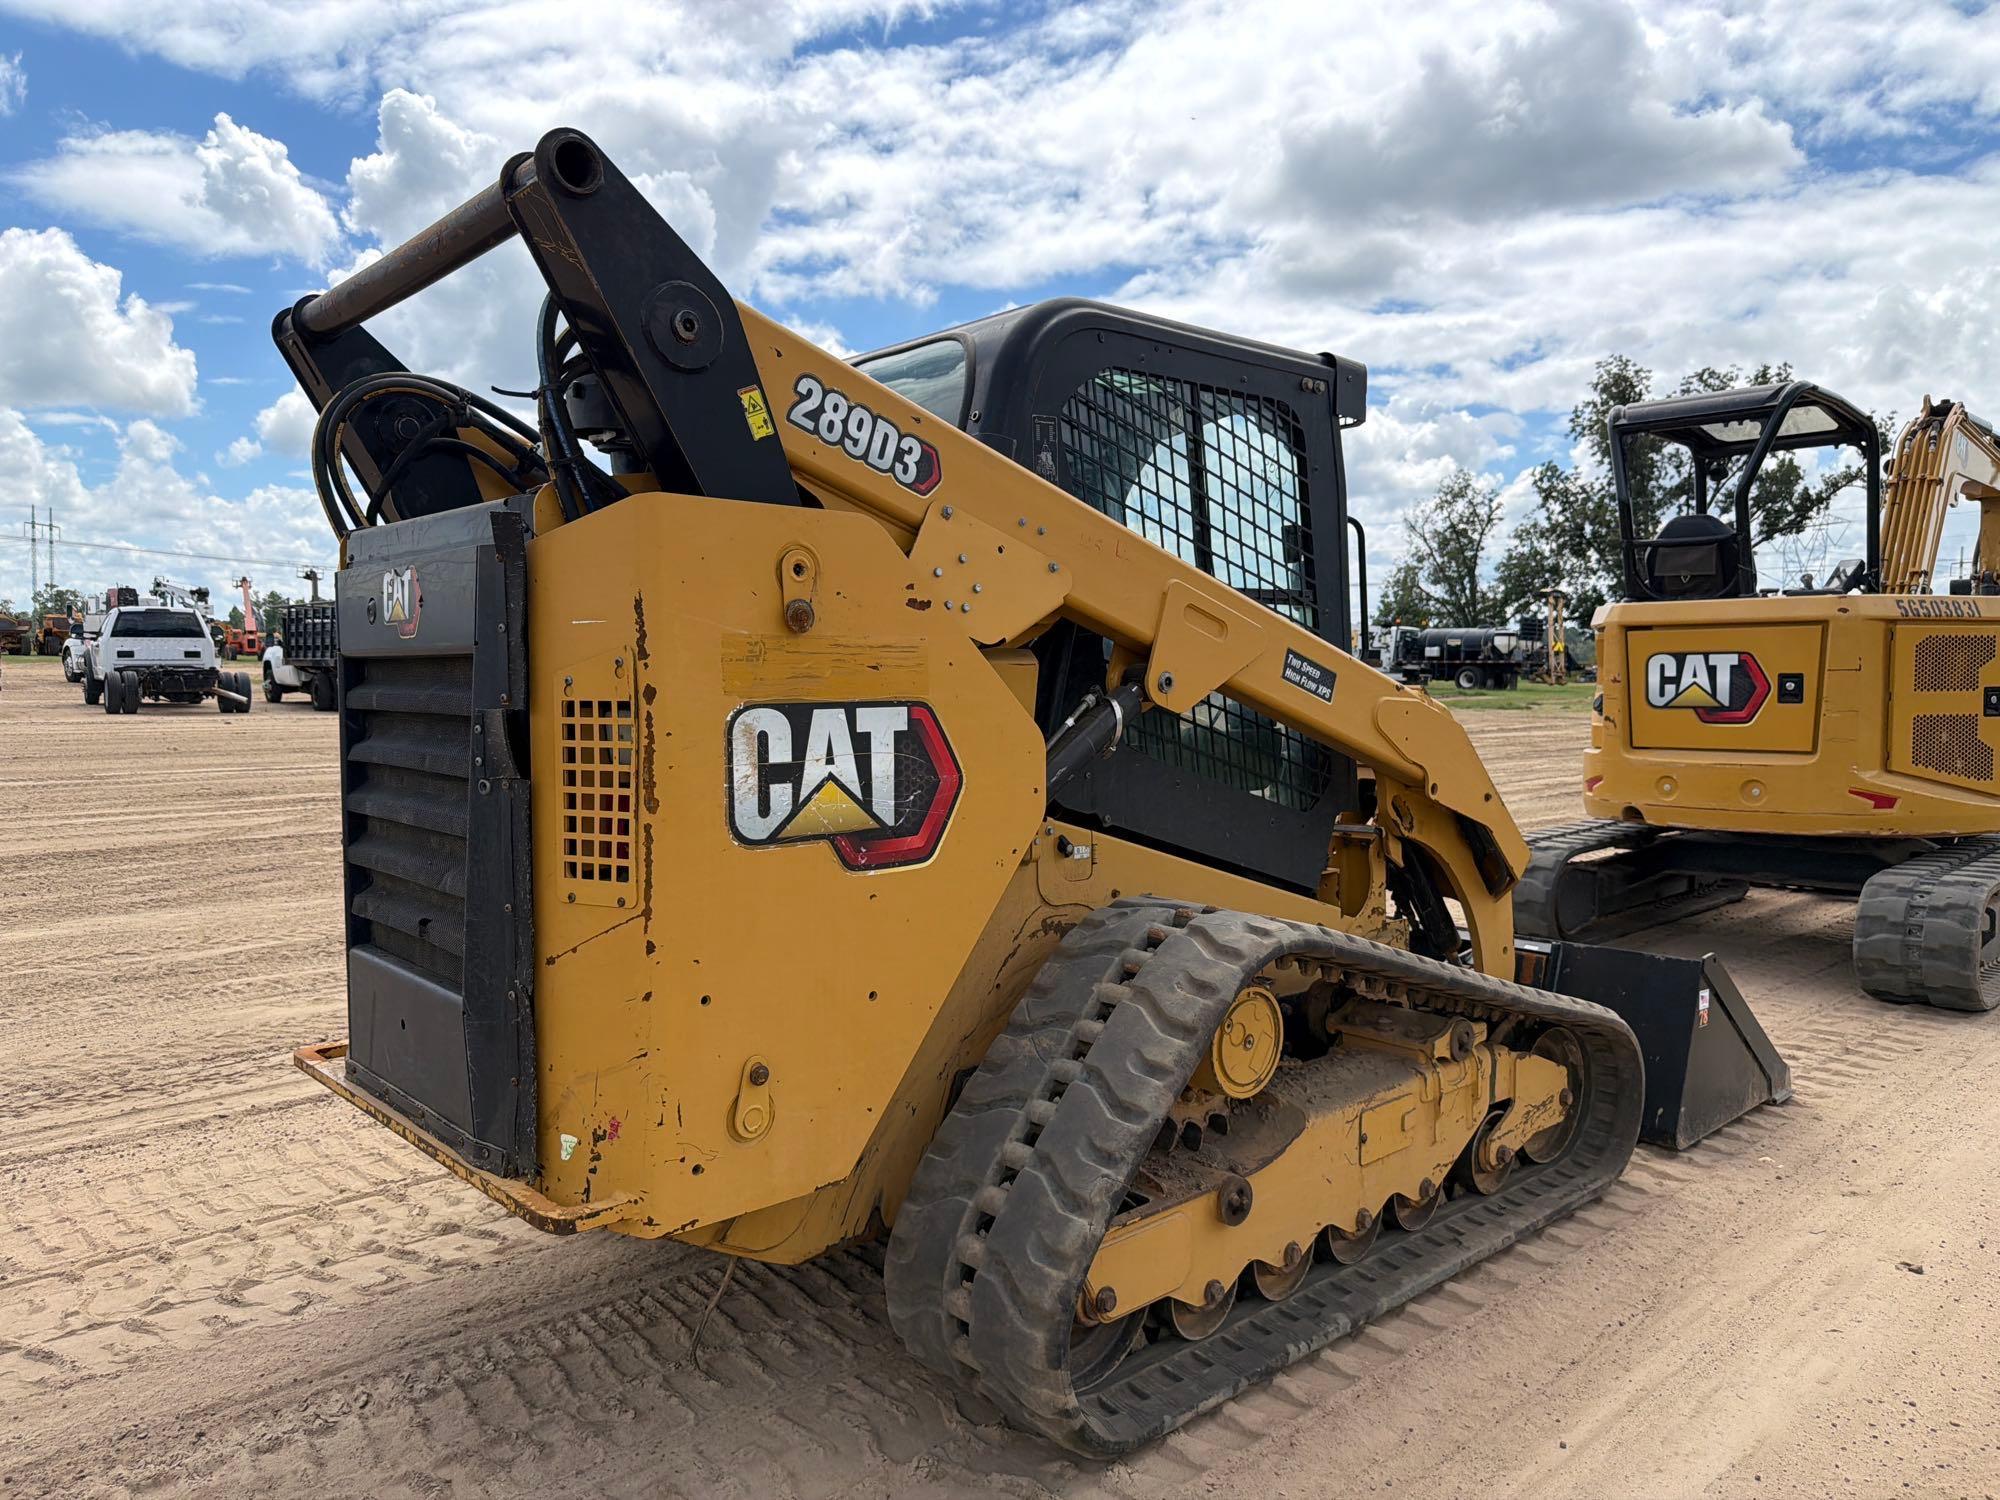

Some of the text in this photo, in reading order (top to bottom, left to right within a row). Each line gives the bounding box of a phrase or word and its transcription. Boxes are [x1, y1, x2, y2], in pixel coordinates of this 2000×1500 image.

[789, 377, 922, 484] 289D3
[383, 569, 411, 621] CAT
[1896, 599, 1982, 618] 5G503831
[1316, 684, 1332, 699] XPS
[1647, 653, 1739, 707] CAT
[732, 706, 908, 840] CAT
